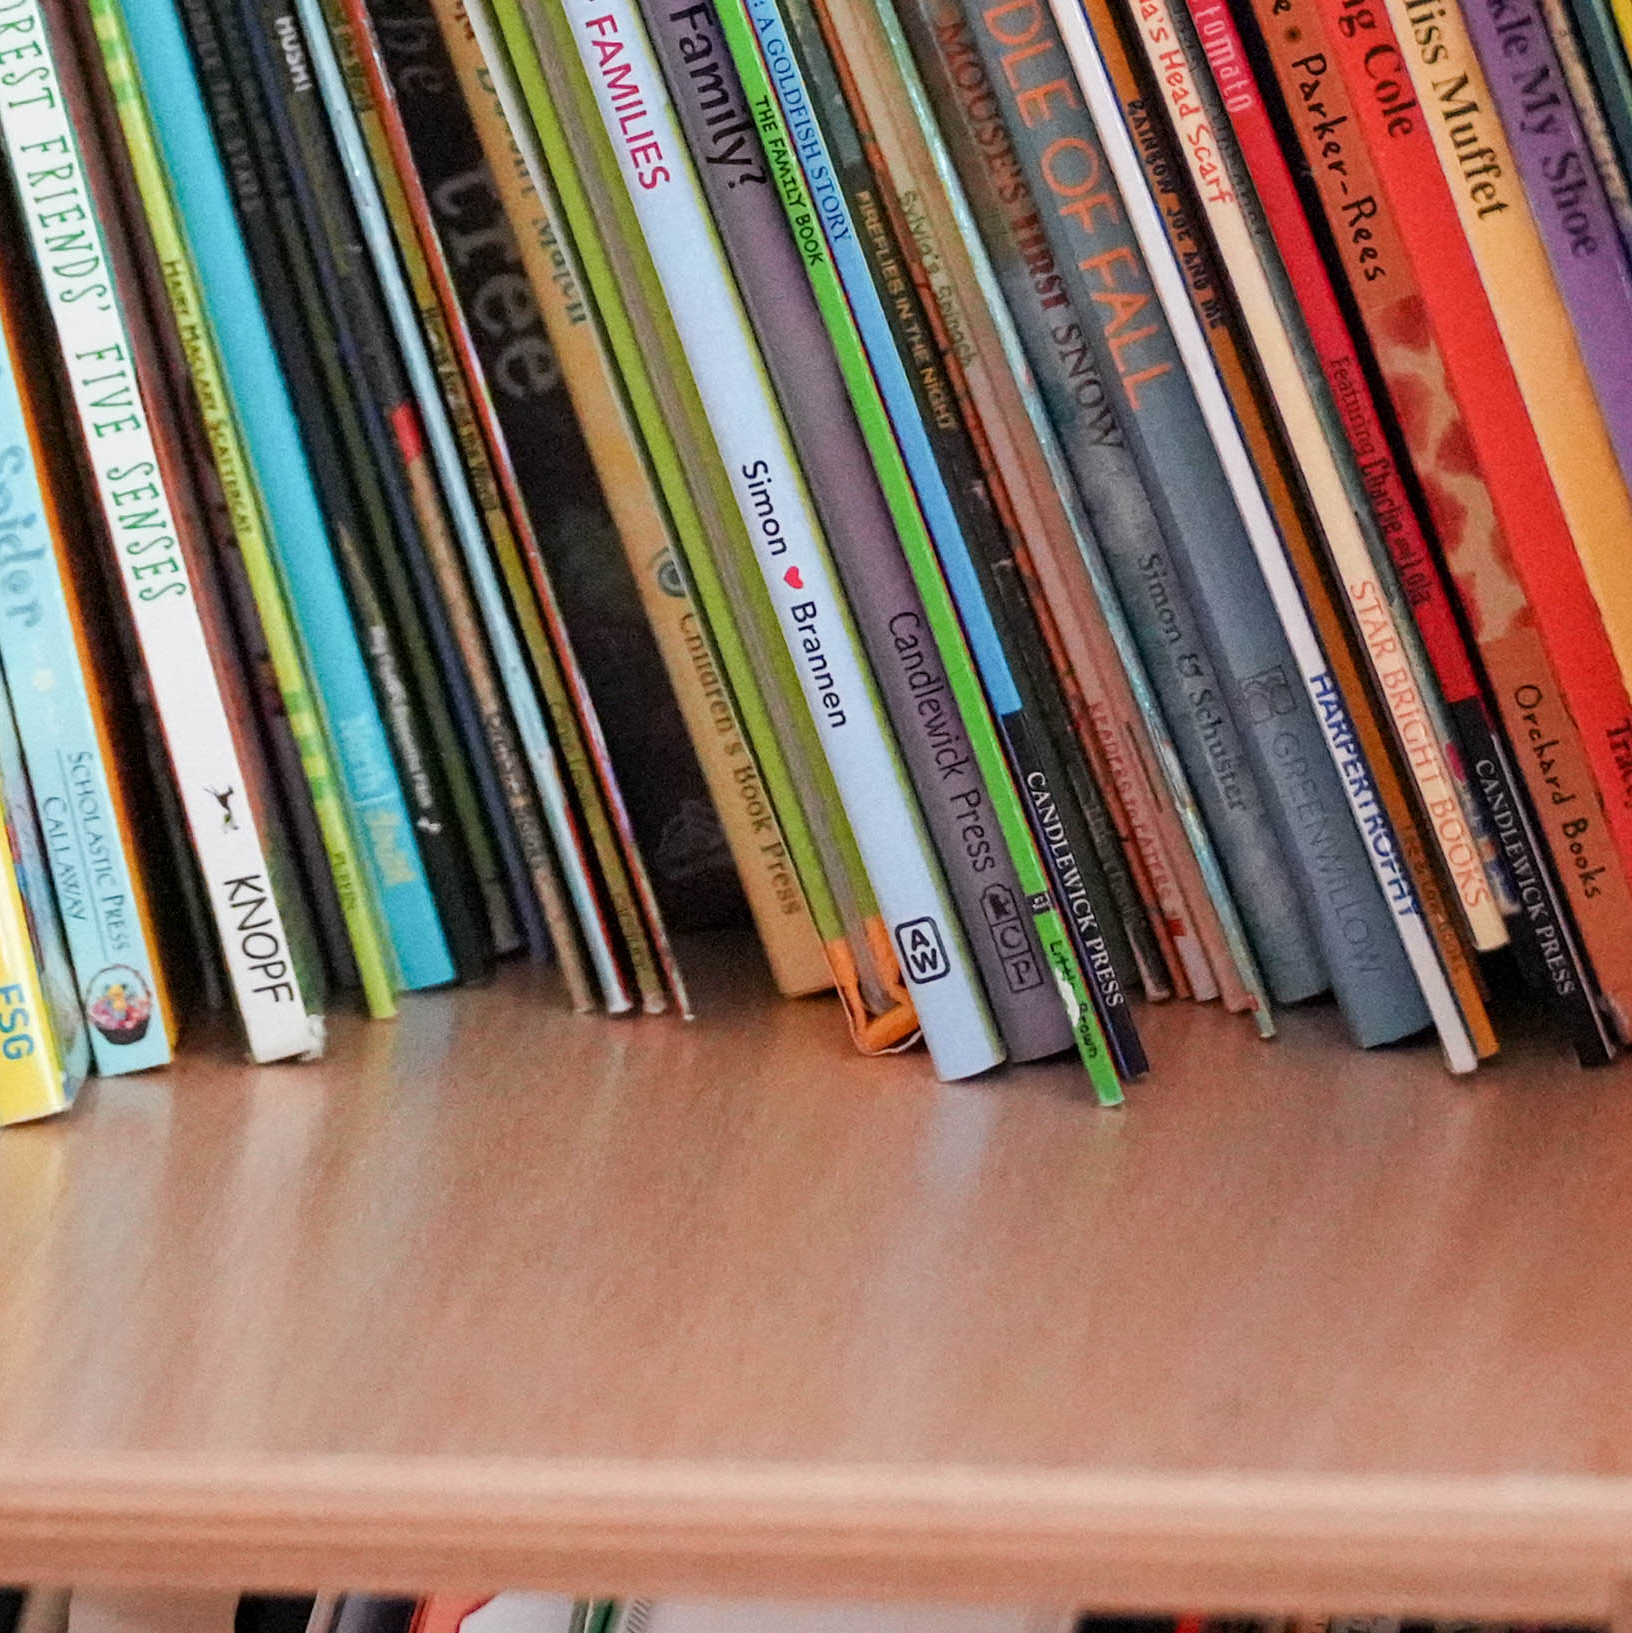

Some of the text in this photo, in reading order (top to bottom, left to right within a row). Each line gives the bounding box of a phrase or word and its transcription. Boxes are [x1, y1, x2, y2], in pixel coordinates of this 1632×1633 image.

[581, 10, 674, 192] FAMILIES
[652, 0, 769, 199] Family?
[753, 11, 778, 32] A
[760, 31, 823, 159] GOLDFISH
[1192, 4, 1258, 115] tomato
[1356, 37, 1427, 141] Cole
[751, 93, 827, 267] THE FAMILY BOOK
[1152, 47, 1201, 121] Head
[1180, 124, 1235, 210] Scarf
[1279, 49, 1405, 284] Parker-Rees
[1428, 70, 1515, 222] Muffet
[1500, 61, 1575, 152] My
[16, 132, 112, 325] FRIENDS'
[806, 160, 853, 243] STORY
[1031, 130, 1119, 241] OF
[1076, 244, 1185, 409] FALL
[1535, 143, 1616, 262] Shoe
[73, 341, 142, 441] FIVE
[103, 457, 187, 606] SENSES
[736, 456, 856, 730] Simon Brannen
[879, 607, 1004, 876] Candlewick Press
[1345, 577, 1490, 909] STAR BRIGHT BOOKS
[1503, 678, 1615, 902] Orchard Books
[222, 869, 295, 1010] KNOPF
[1022, 766, 1126, 1008] CANDLEWICK PRESS
